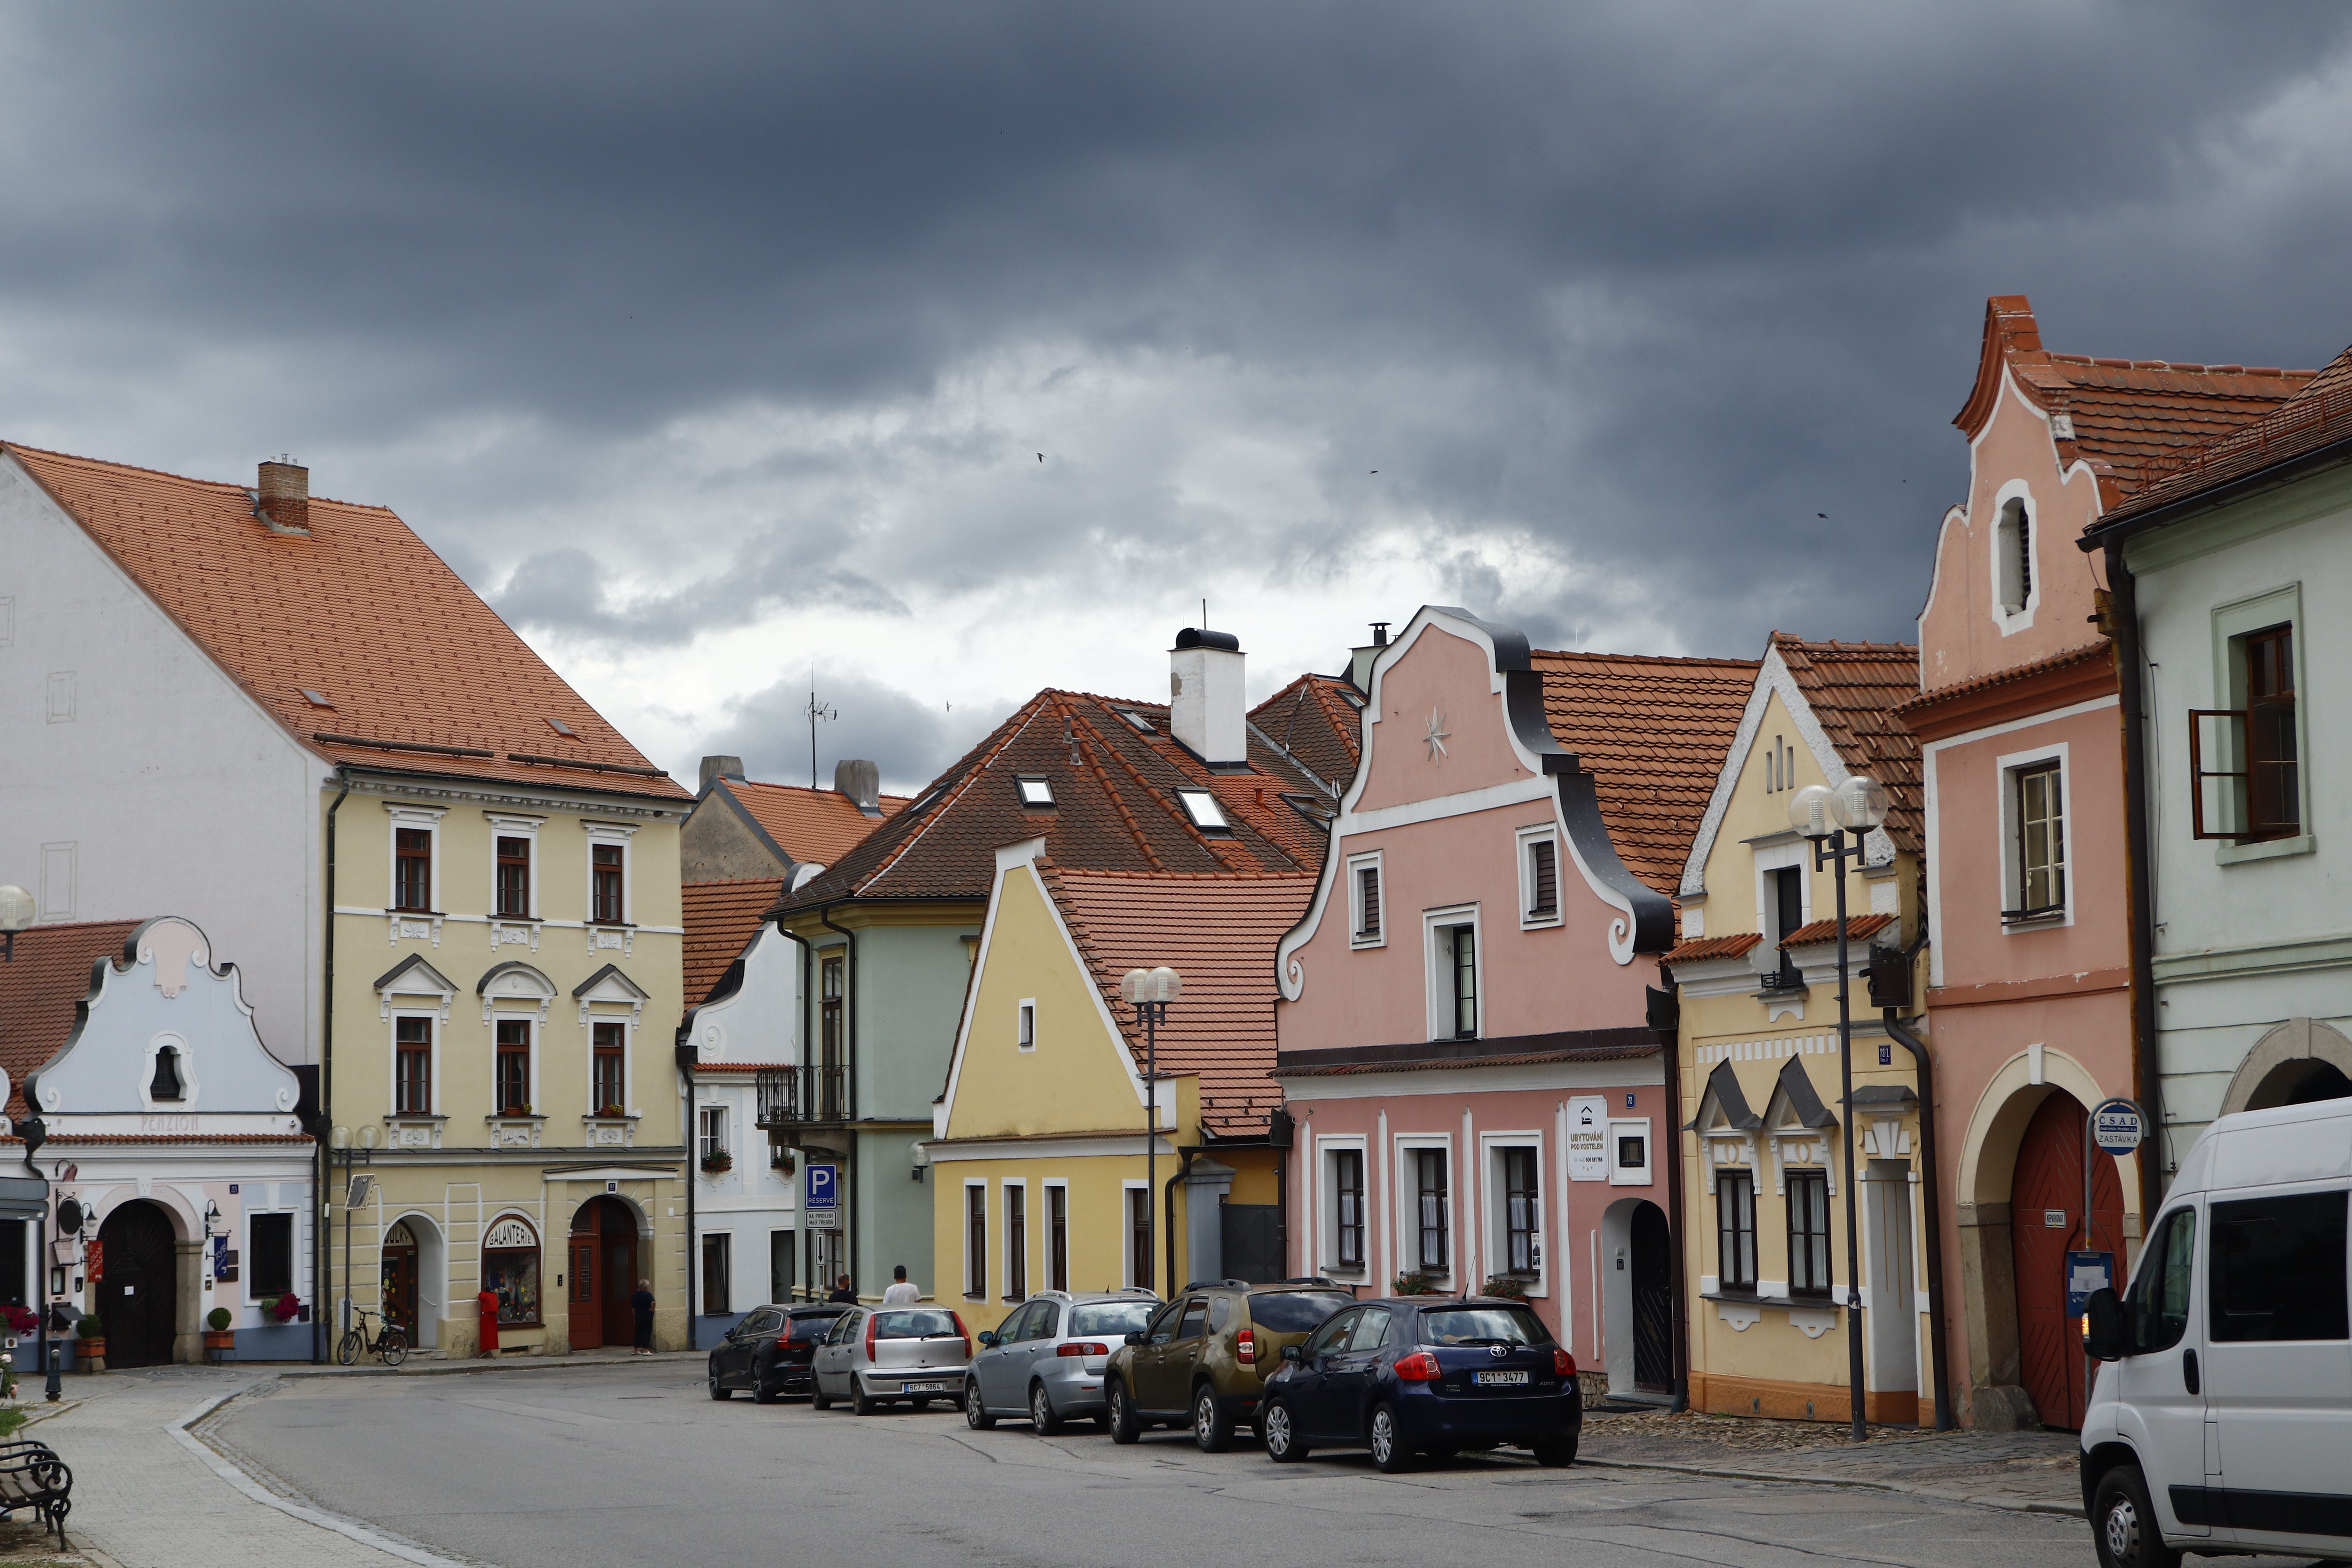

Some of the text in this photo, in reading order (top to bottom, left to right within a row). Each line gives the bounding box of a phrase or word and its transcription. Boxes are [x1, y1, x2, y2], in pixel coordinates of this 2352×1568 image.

[1628, 1096, 1632, 1104] 72
[141, 1116, 198, 1131] PENZION
[1570, 1131, 1603, 1142] UBYTOVÁNÍ
[2099, 1135, 2138, 1143] ZASTÁVKA
[812, 1170, 829, 1195] P
[489, 1224, 532, 1245] GALANTERIE
[1479, 1373, 1496, 1382] 9C1
[1503, 1372, 1524, 1382] 3477
